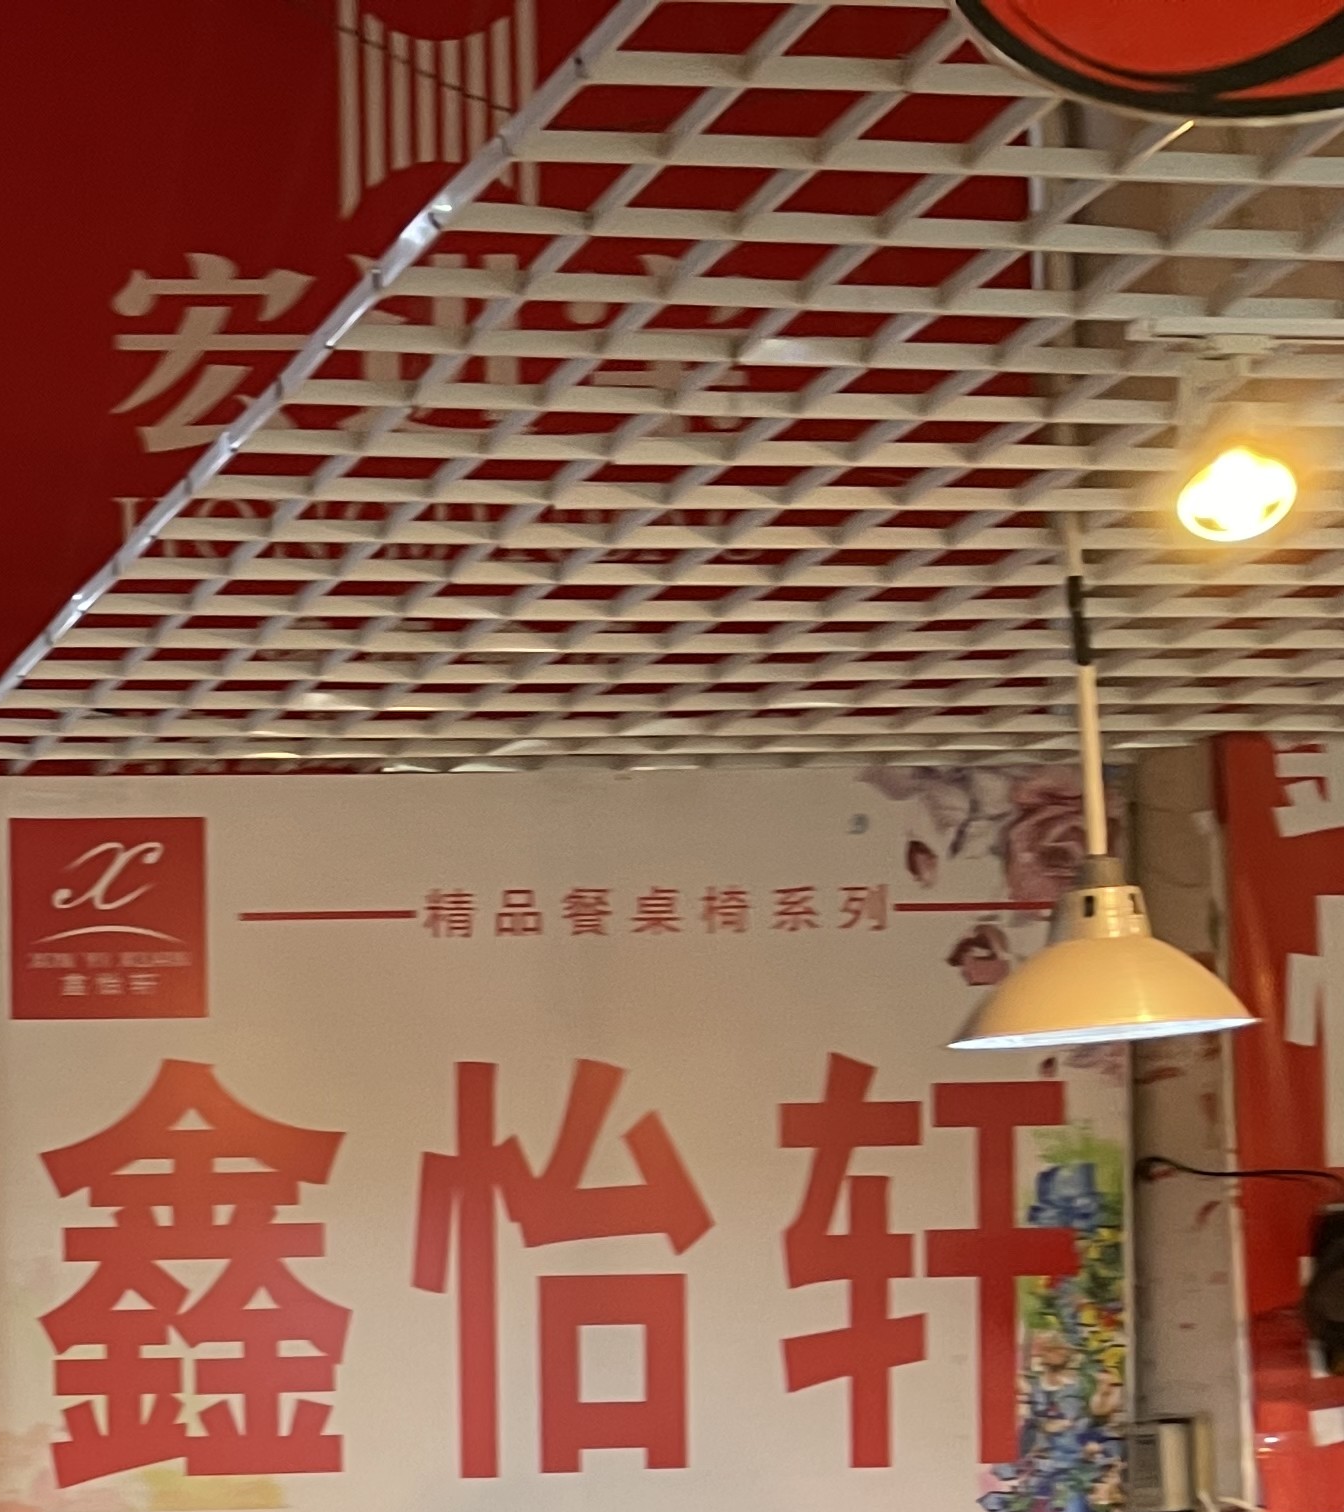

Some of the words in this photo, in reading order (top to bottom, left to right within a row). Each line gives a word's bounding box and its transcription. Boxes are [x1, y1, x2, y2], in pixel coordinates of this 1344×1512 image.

[424, 883, 890, 938] 精品餐桌椅系列
[37, 1051, 1081, 1490] 鑫怡轩
